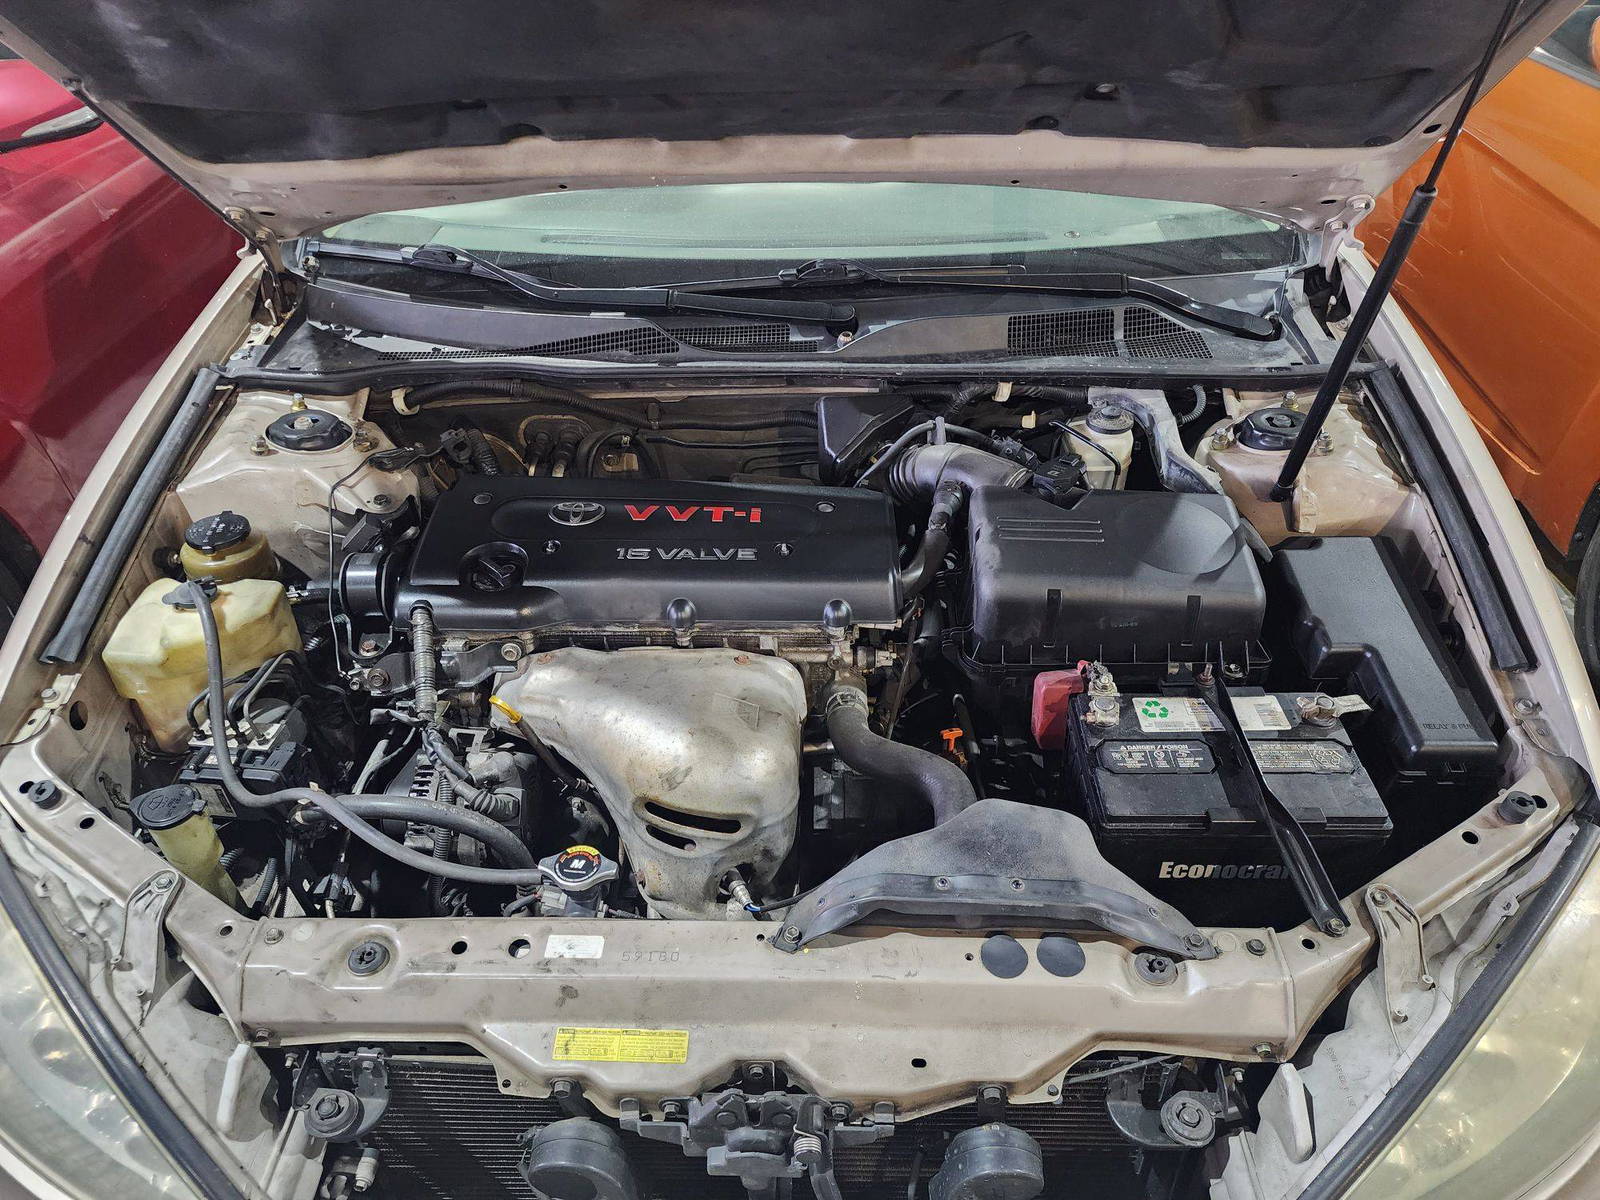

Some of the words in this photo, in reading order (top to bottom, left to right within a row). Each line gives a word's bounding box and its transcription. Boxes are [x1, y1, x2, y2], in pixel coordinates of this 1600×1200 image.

[623, 504, 762, 523] VVT-i
[616, 547, 651, 561] 16
[656, 547, 758, 561] VALVE
